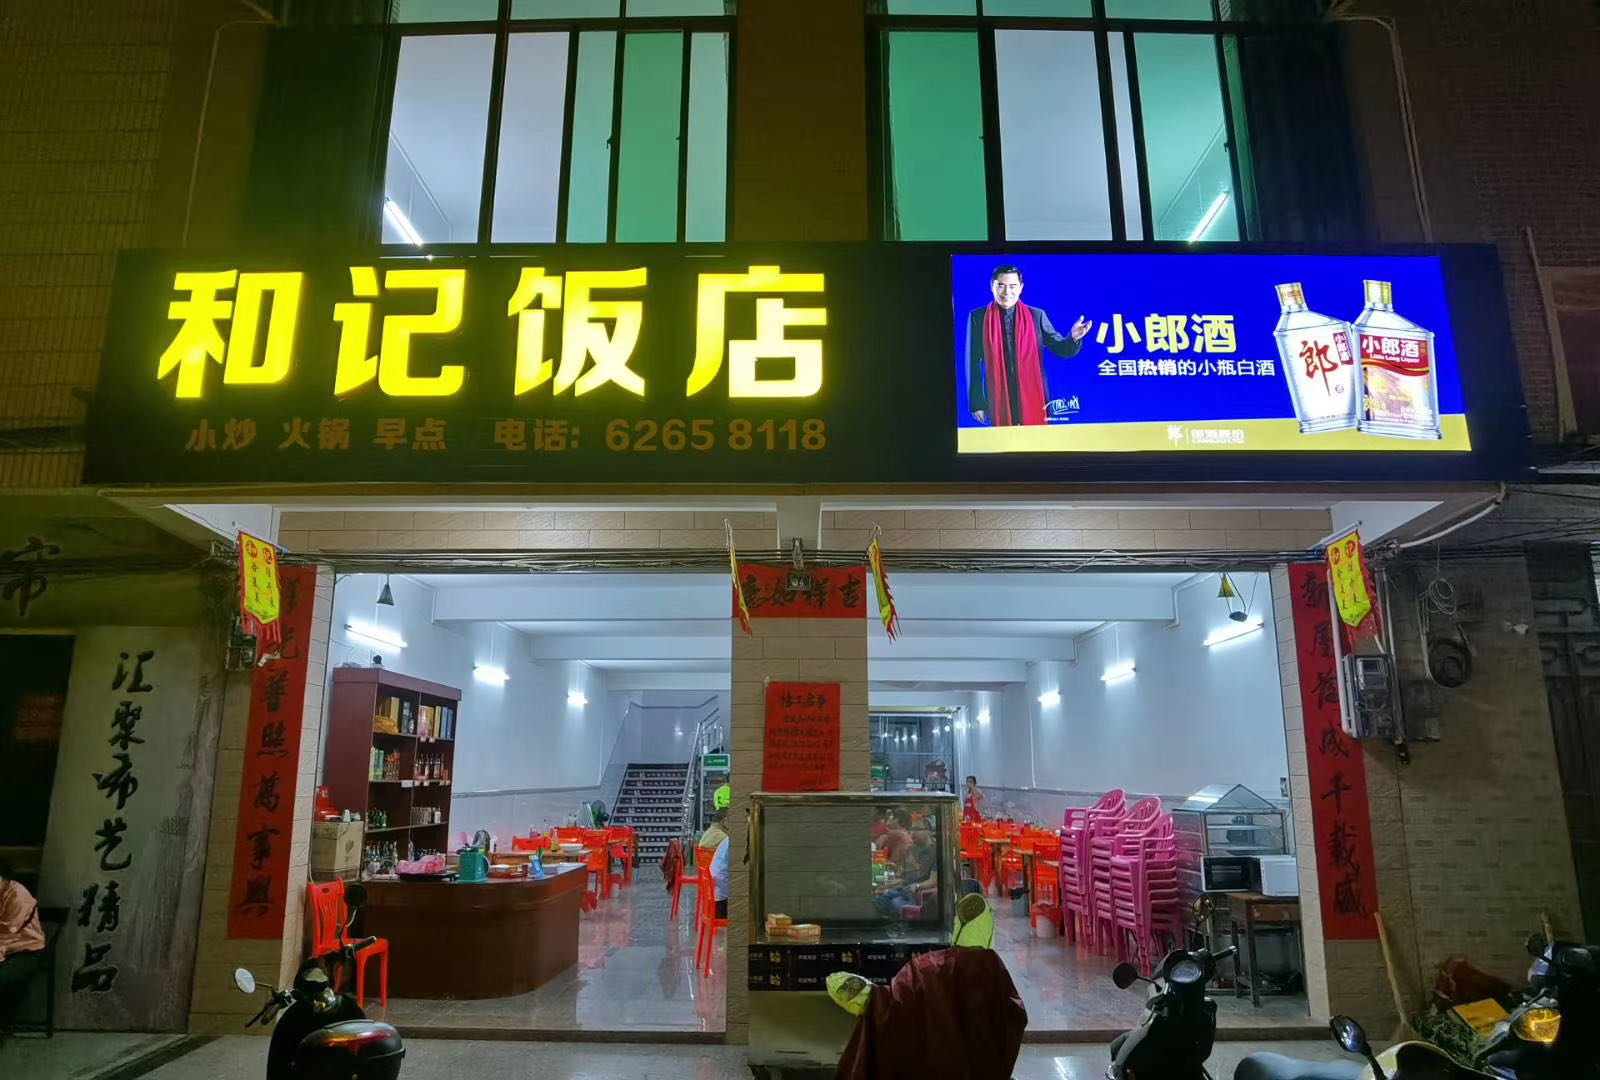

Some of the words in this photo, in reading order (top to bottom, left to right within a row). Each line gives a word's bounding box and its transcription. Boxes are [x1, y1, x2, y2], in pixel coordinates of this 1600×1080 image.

[157, 265, 828, 399] 和记饭店
[1096, 313, 1237, 354] 小郎酒
[1362, 336, 1420, 358] 小郎酒
[1098, 359, 1276, 377] 全国热销的小瓶白酒
[1299, 340, 1339, 398] 郎
[185, 418, 257, 451] 小炒
[278, 418, 350, 450] 火锅
[373, 418, 448, 450] 早点
[605, 418, 715, 451] 6265
[728, 418, 827, 451] 8118
